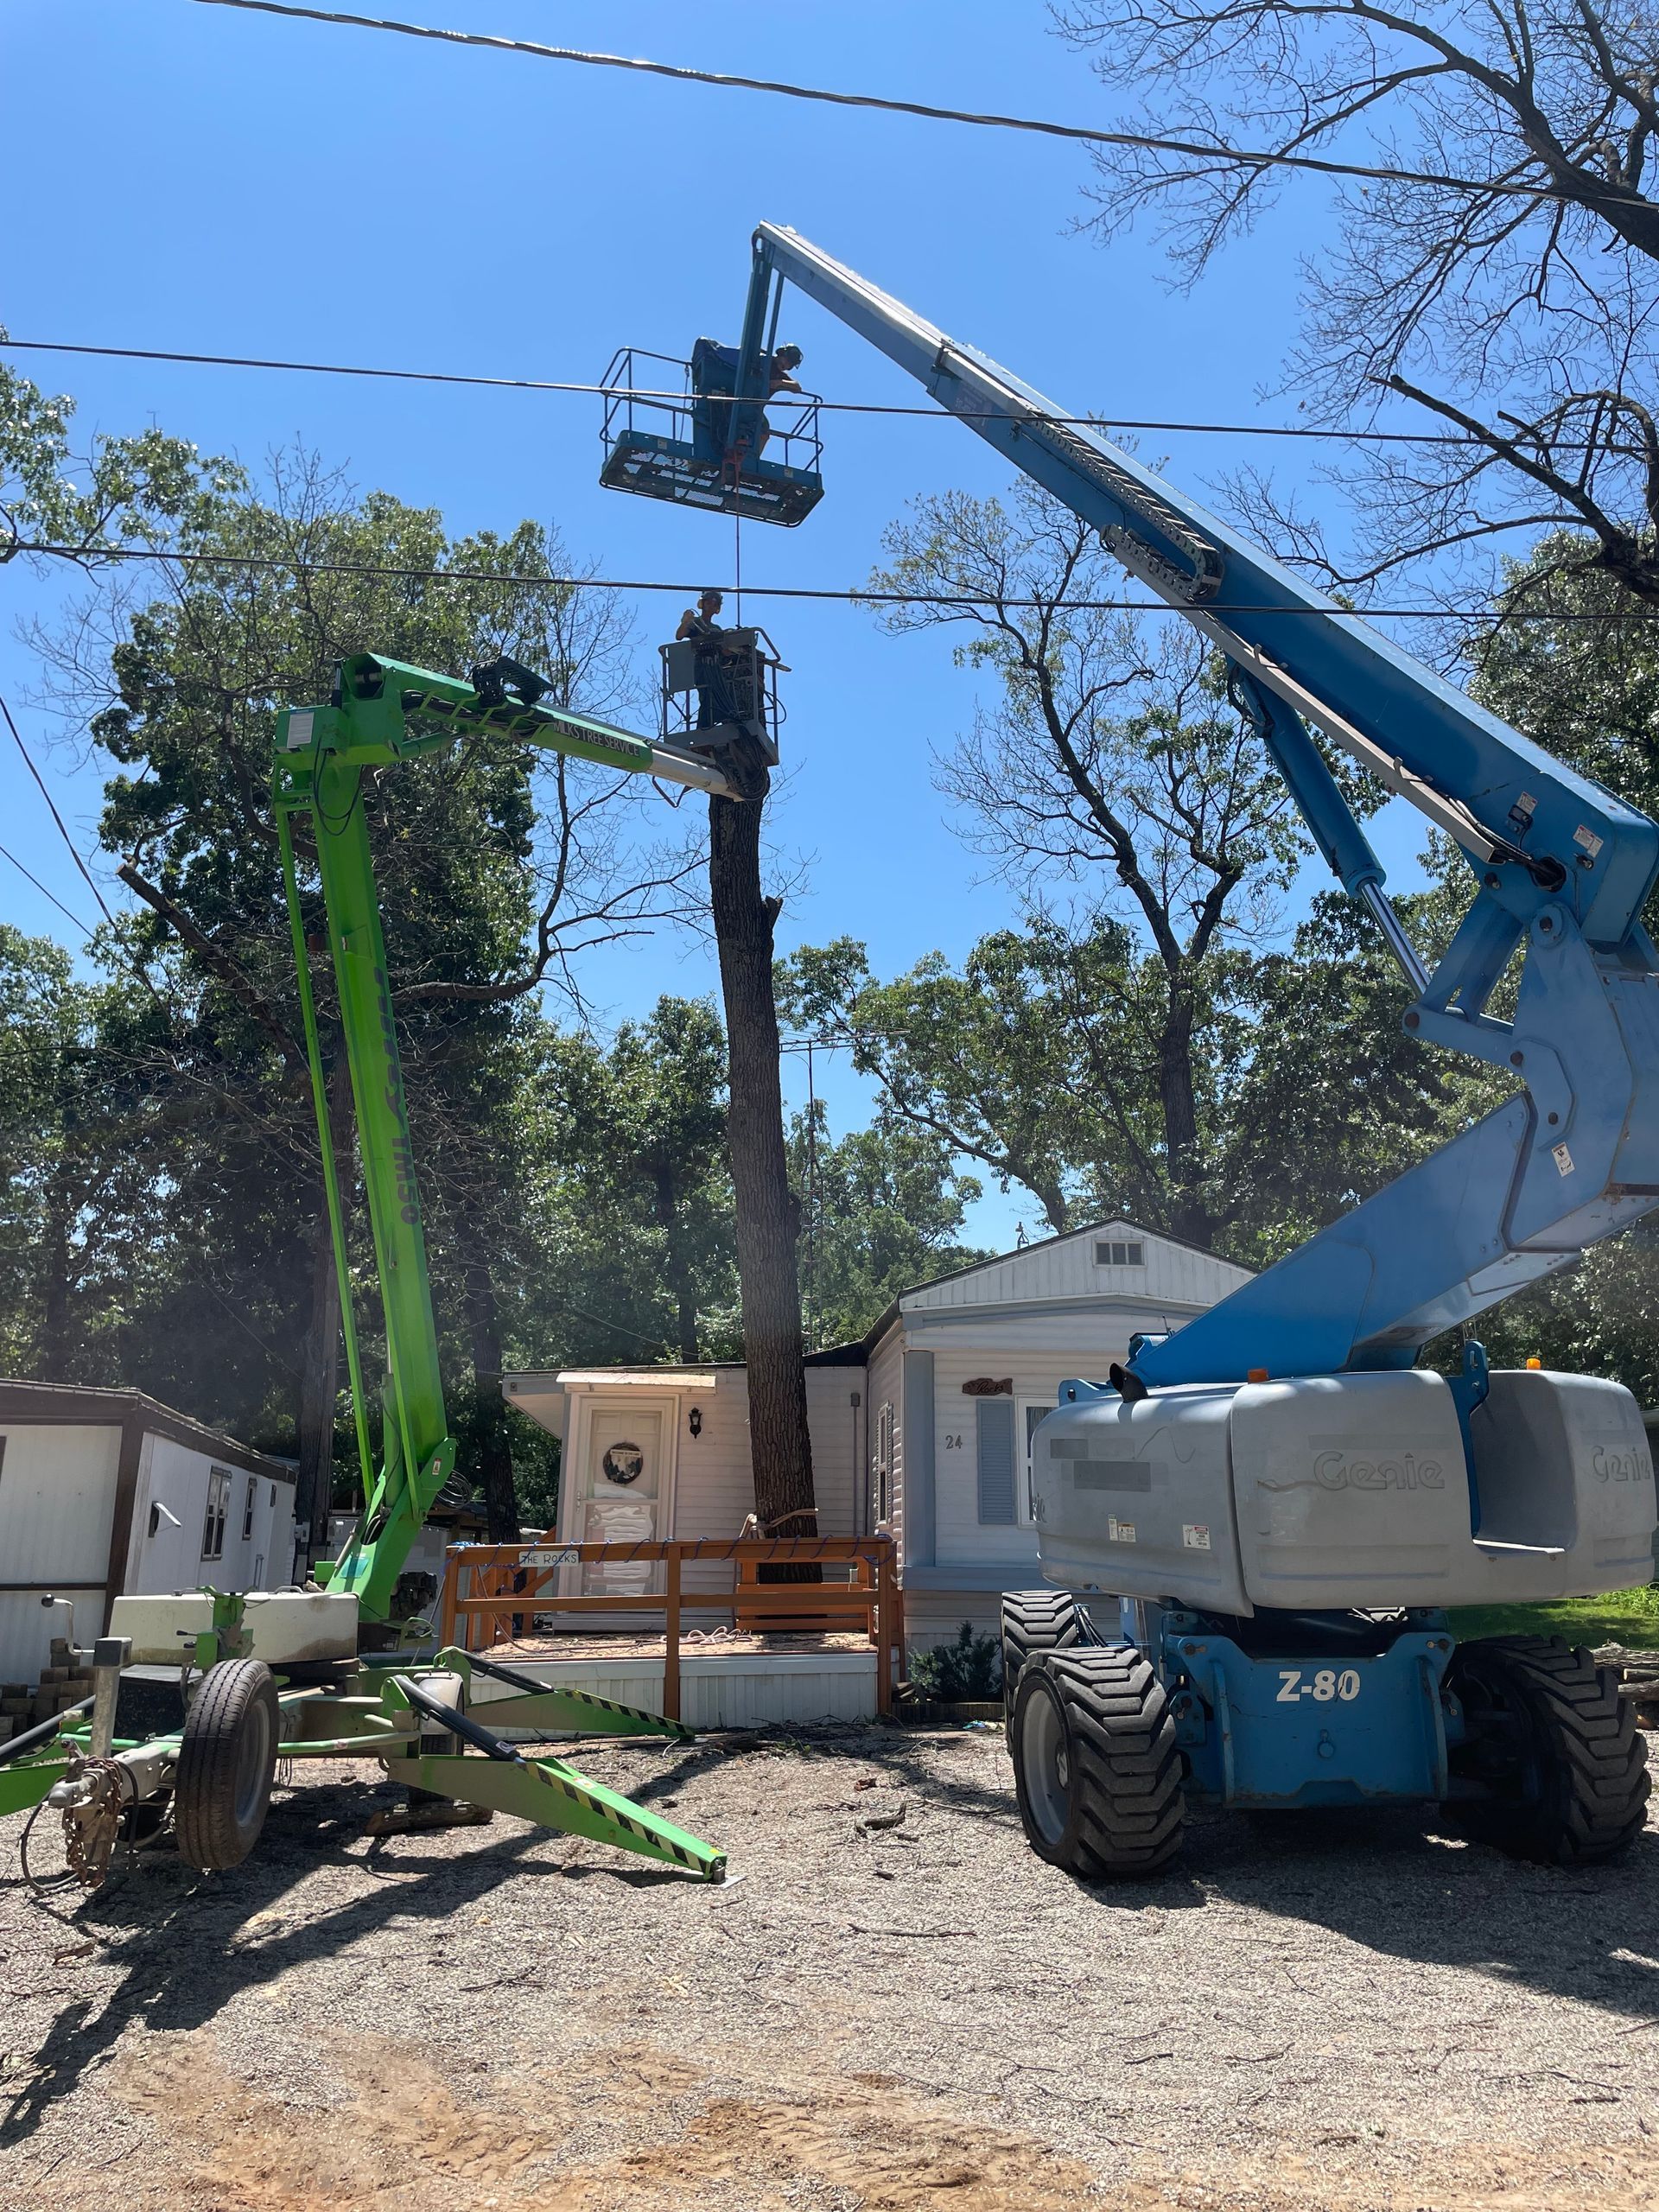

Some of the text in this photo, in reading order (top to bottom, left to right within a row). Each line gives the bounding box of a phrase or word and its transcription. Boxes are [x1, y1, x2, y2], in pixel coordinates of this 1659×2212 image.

[580, 727, 603, 746] TREE
[604, 734, 639, 756] SERVICE
[391, 1133, 419, 1225] TM50
[945, 1434, 963, 1449] 24
[1313, 1450, 1446, 1491] Genie
[1591, 1445, 1651, 1483] Genie
[521, 1555, 539, 1564] THE
[1276, 1669, 1361, 1701] Z-80
